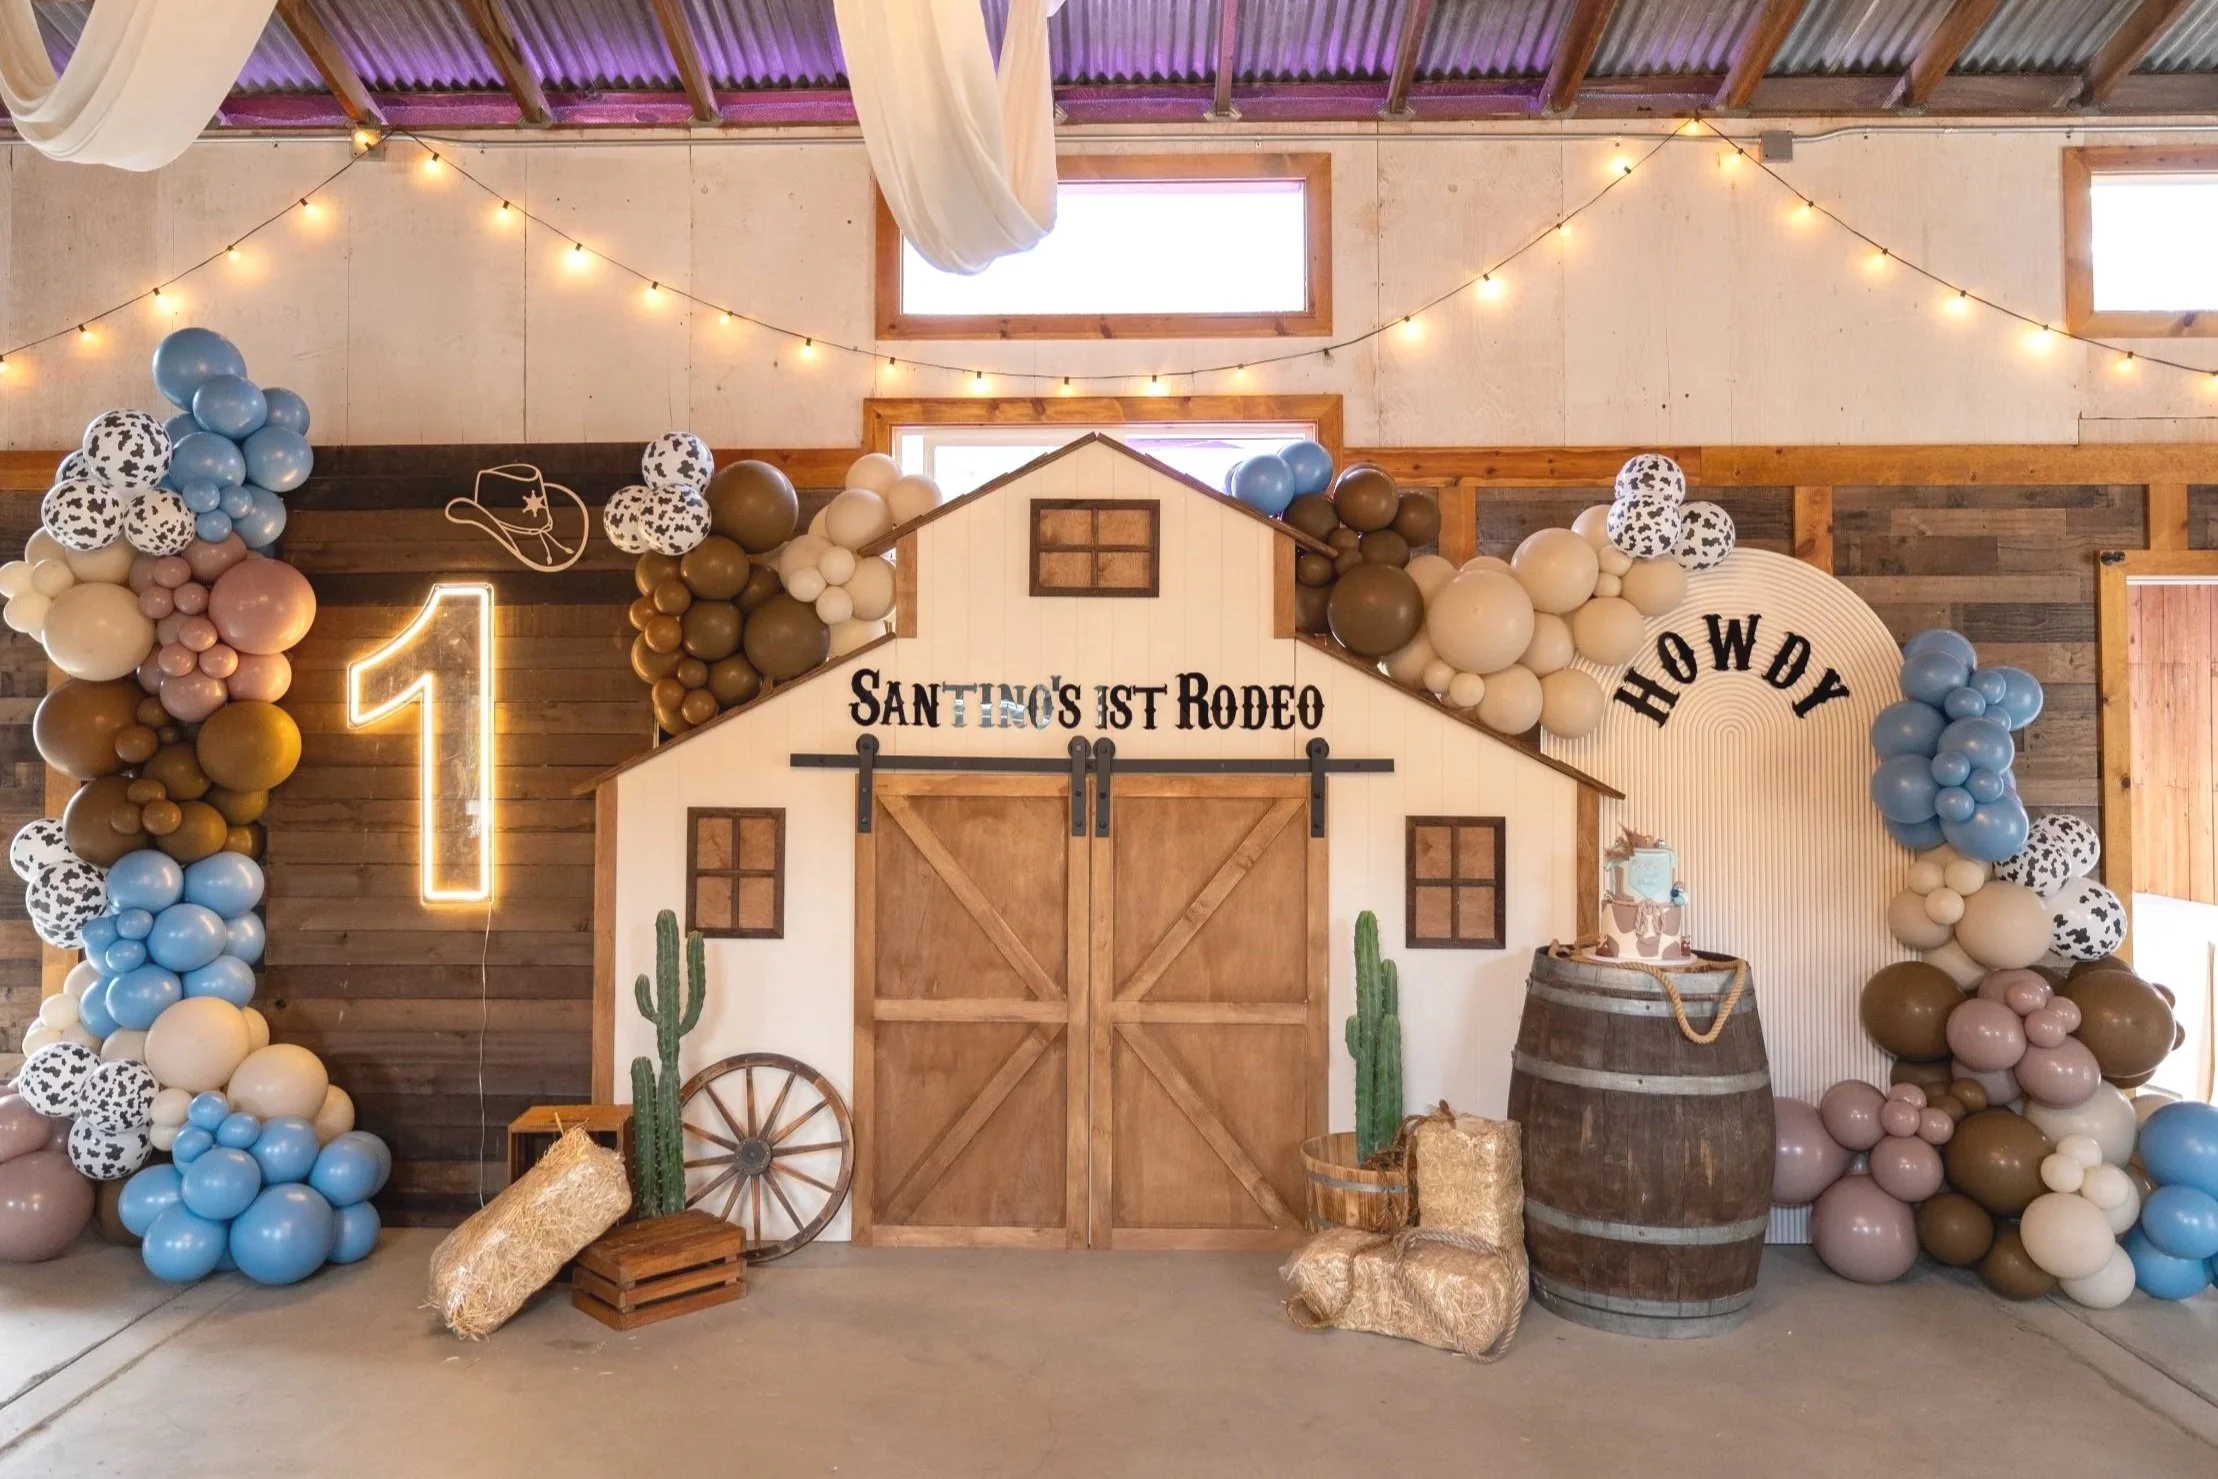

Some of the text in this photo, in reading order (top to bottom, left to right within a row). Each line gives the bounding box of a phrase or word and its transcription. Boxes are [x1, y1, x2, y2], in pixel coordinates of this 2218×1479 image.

[1175, 671, 1325, 730] RODEO
[1613, 613, 1850, 728] HOWDY
[348, 584, 494, 904] 1
